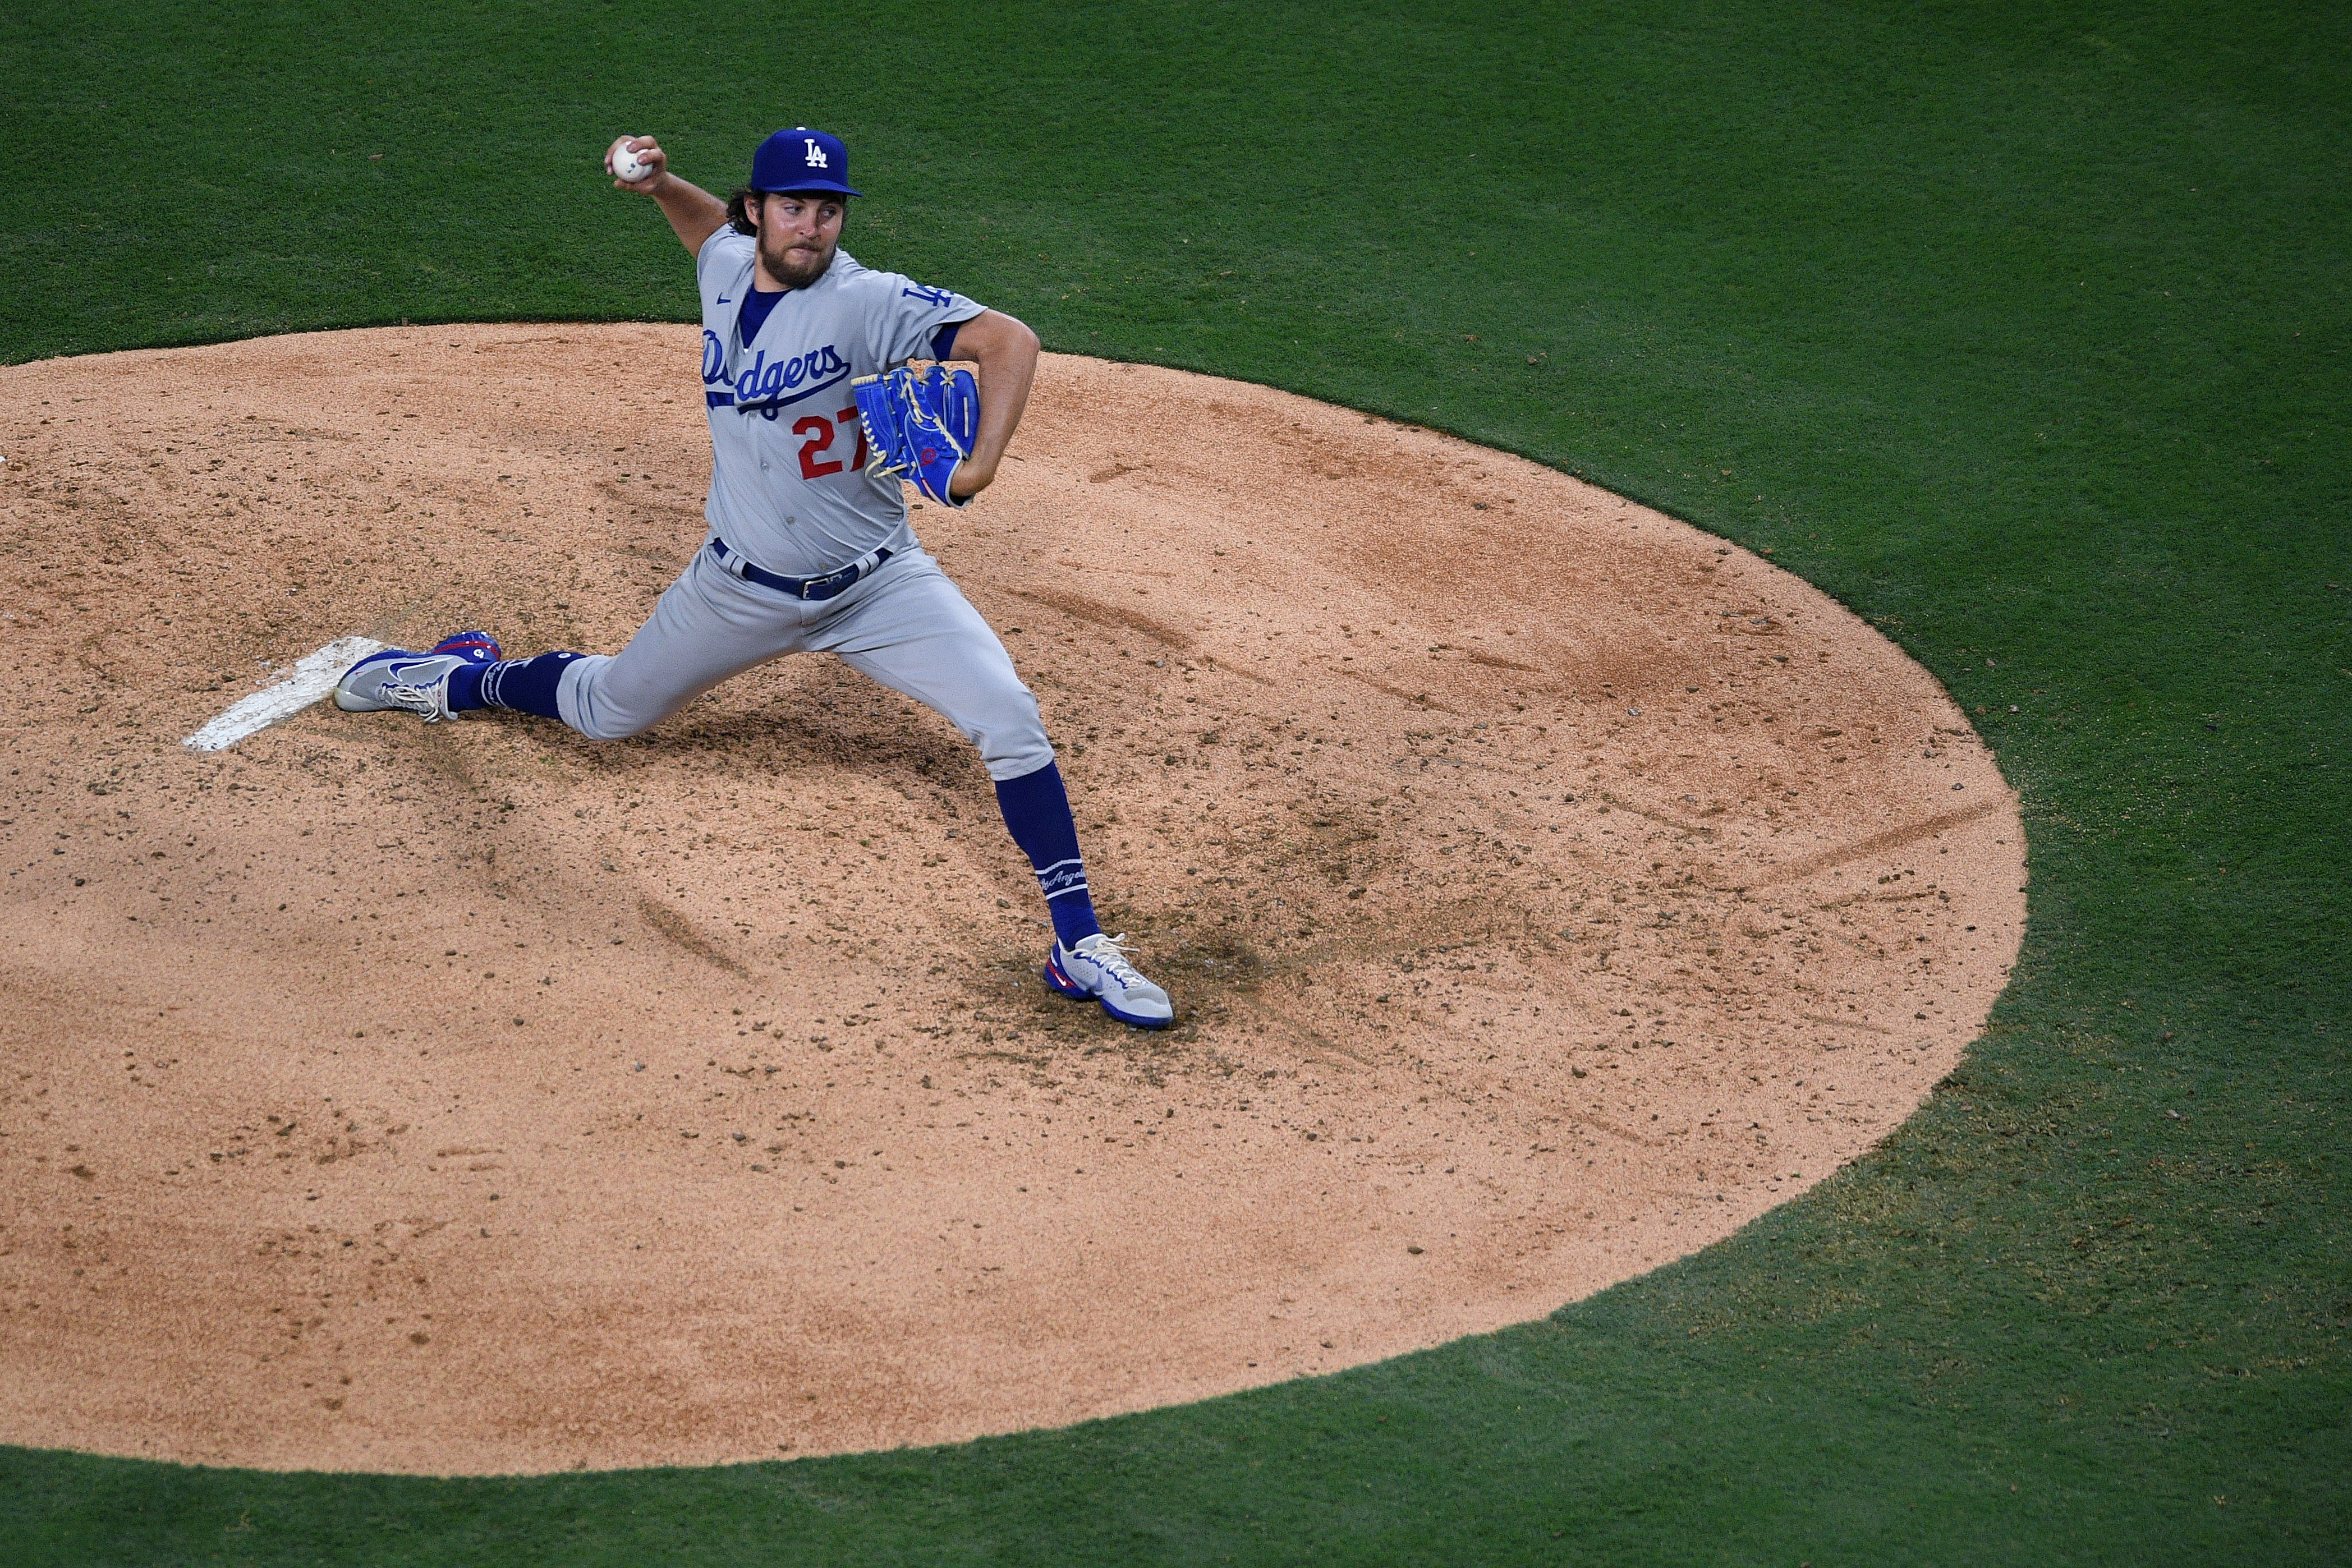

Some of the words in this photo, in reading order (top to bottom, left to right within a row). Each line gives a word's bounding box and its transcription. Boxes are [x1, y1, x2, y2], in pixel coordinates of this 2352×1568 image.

[804, 139, 828, 168] LA
[902, 284, 954, 308] LA
[792, 405, 868, 480] 27
